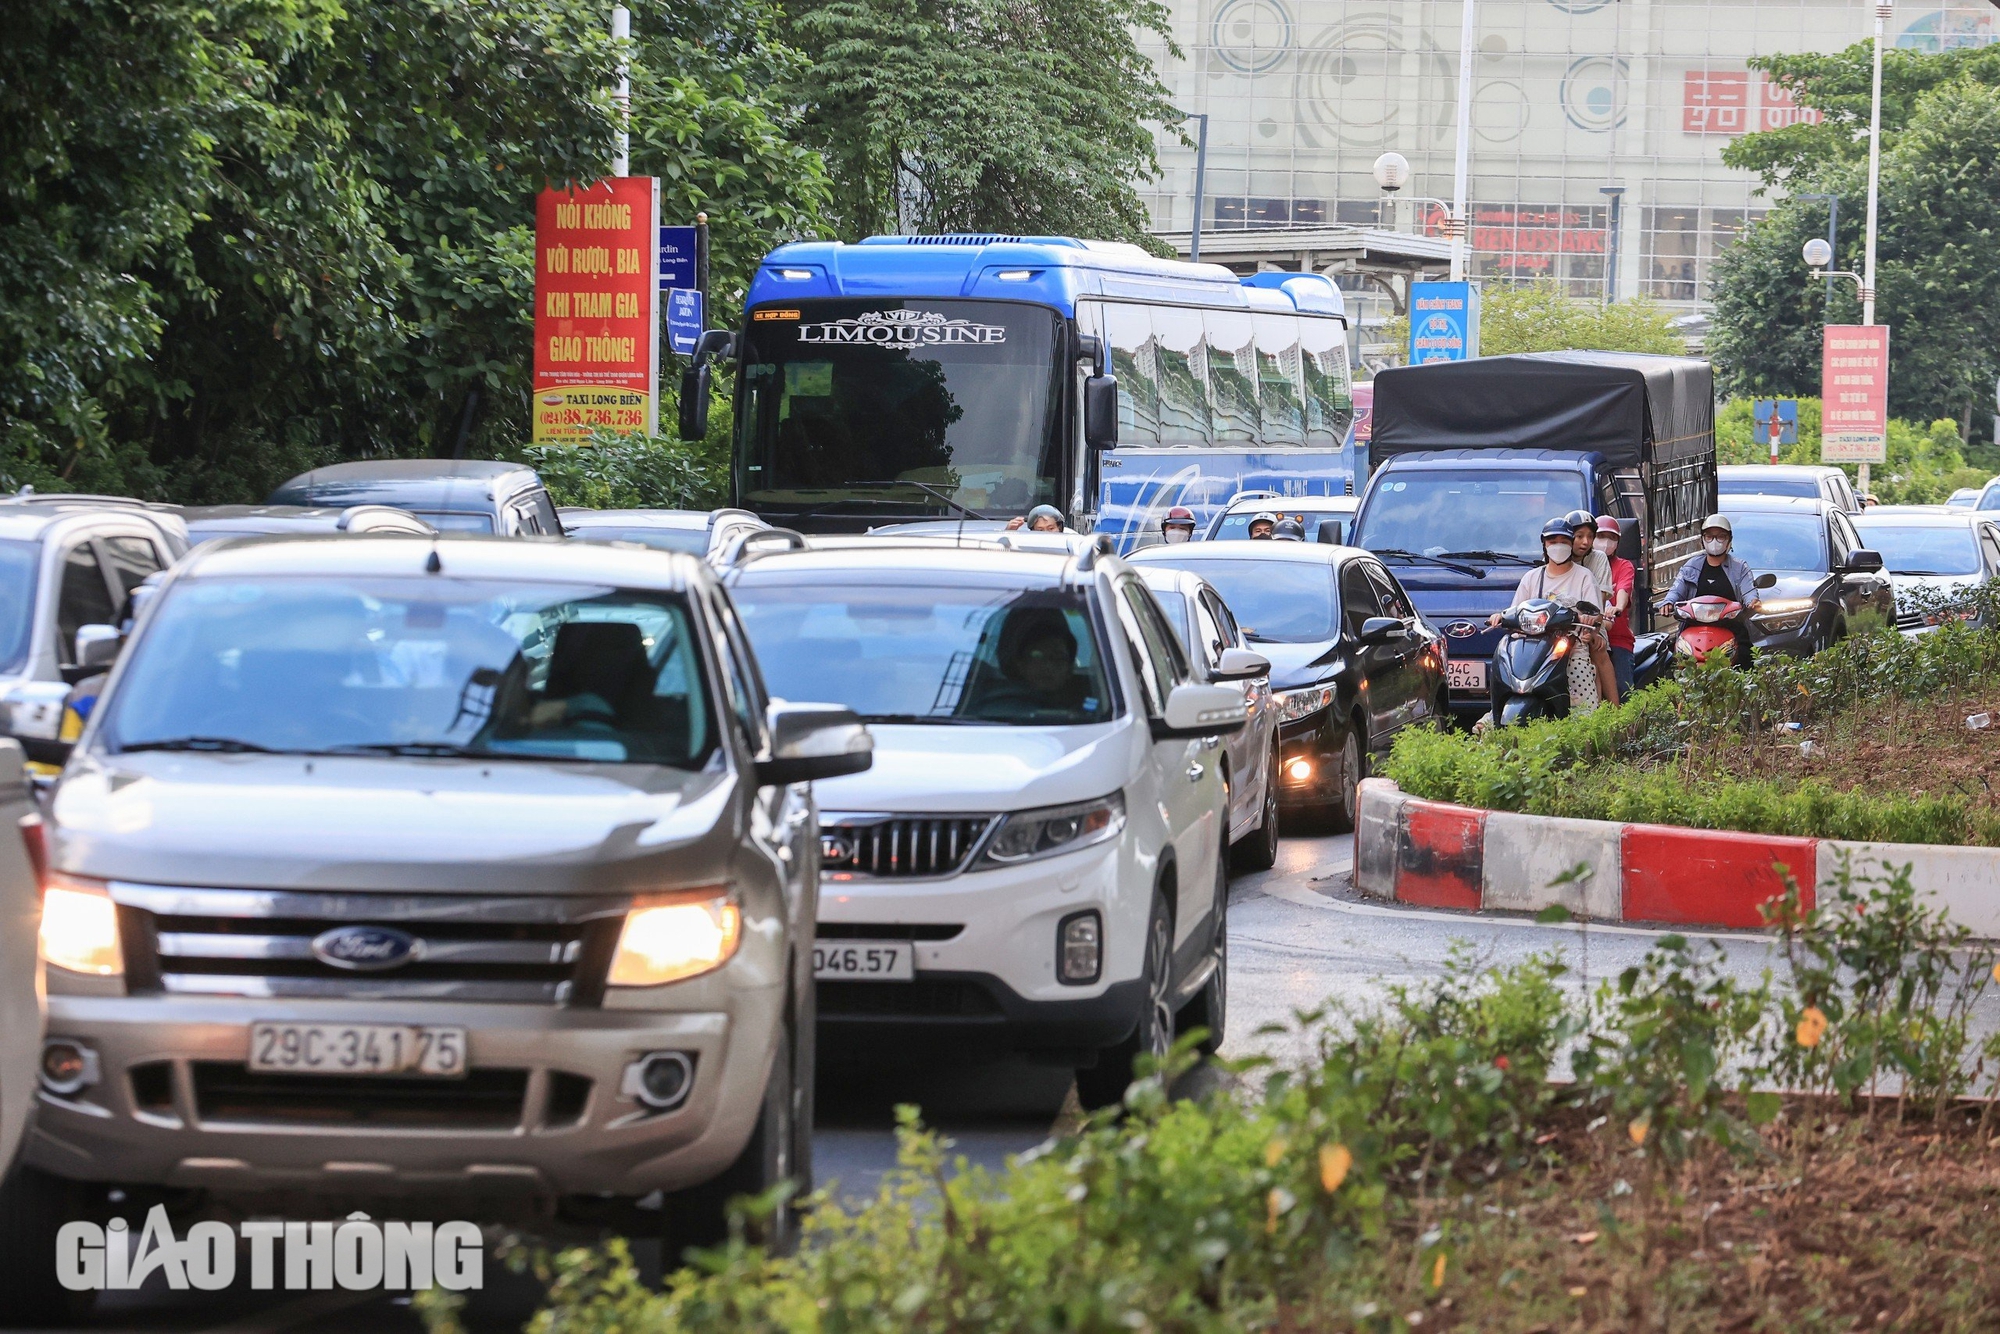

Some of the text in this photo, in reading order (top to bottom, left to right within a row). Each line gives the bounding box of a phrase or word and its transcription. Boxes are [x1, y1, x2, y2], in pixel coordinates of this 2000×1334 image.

[556, 198, 631, 230] NÓI KHÔNG
[659, 245, 679, 254] rdin
[1474, 227, 1608, 253] RENAISSANC
[546, 242, 640, 280] VỚI RƯỢU, BIA
[546, 292, 639, 319] KHI THAM GIA
[888, 311, 917, 320] VIP
[549, 331, 635, 363] GIAO THÔNG!
[797, 325, 1006, 343] LIMOUSINE
[566, 395, 589, 405] TAXI
[592, 395, 617, 405] LONG
[620, 393, 642, 405] BIÊN
